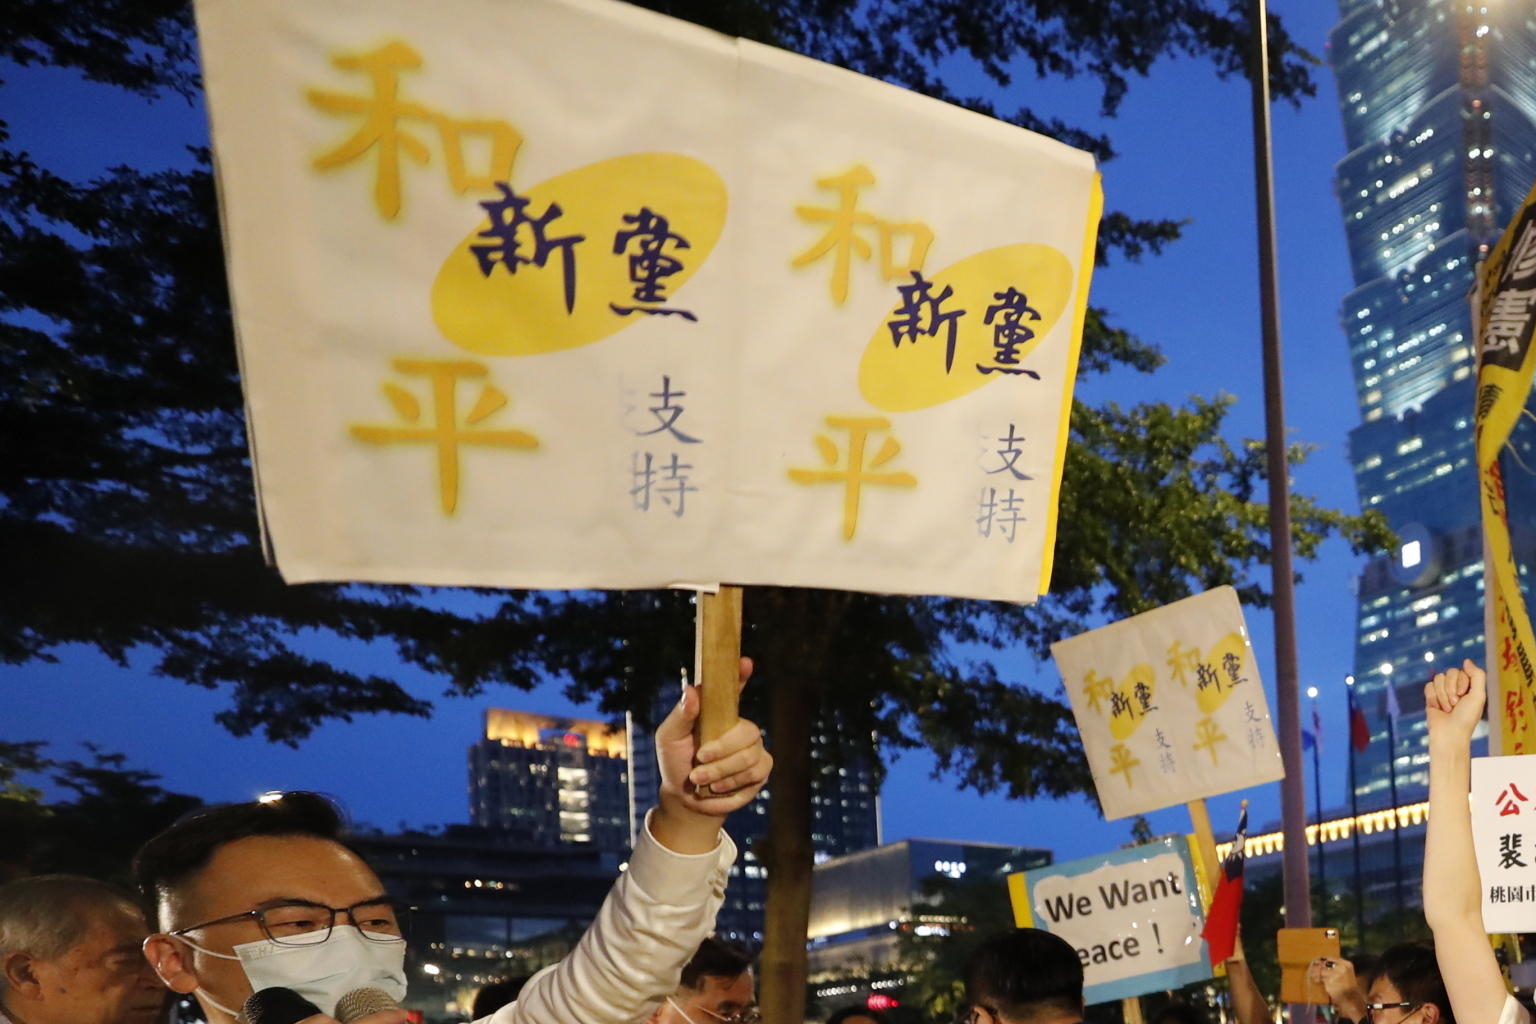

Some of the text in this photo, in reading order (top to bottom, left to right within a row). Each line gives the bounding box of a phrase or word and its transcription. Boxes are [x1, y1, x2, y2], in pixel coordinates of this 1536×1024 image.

[306, 40, 540, 517] 和平
[468, 181, 699, 322] 新黨
[787, 164, 937, 541] 和平
[887, 270, 1042, 381] 新黨
[627, 375, 704, 519] 支持
[975, 423, 1035, 544] 支持
[1082, 668, 1141, 790] 和平
[1110, 681, 1159, 720] 新黨
[1166, 638, 1227, 768] 和平
[1196, 652, 1248, 694] 新黨
[1044, 871, 1183, 923] We Want
[1076, 935, 1140, 968] eace
